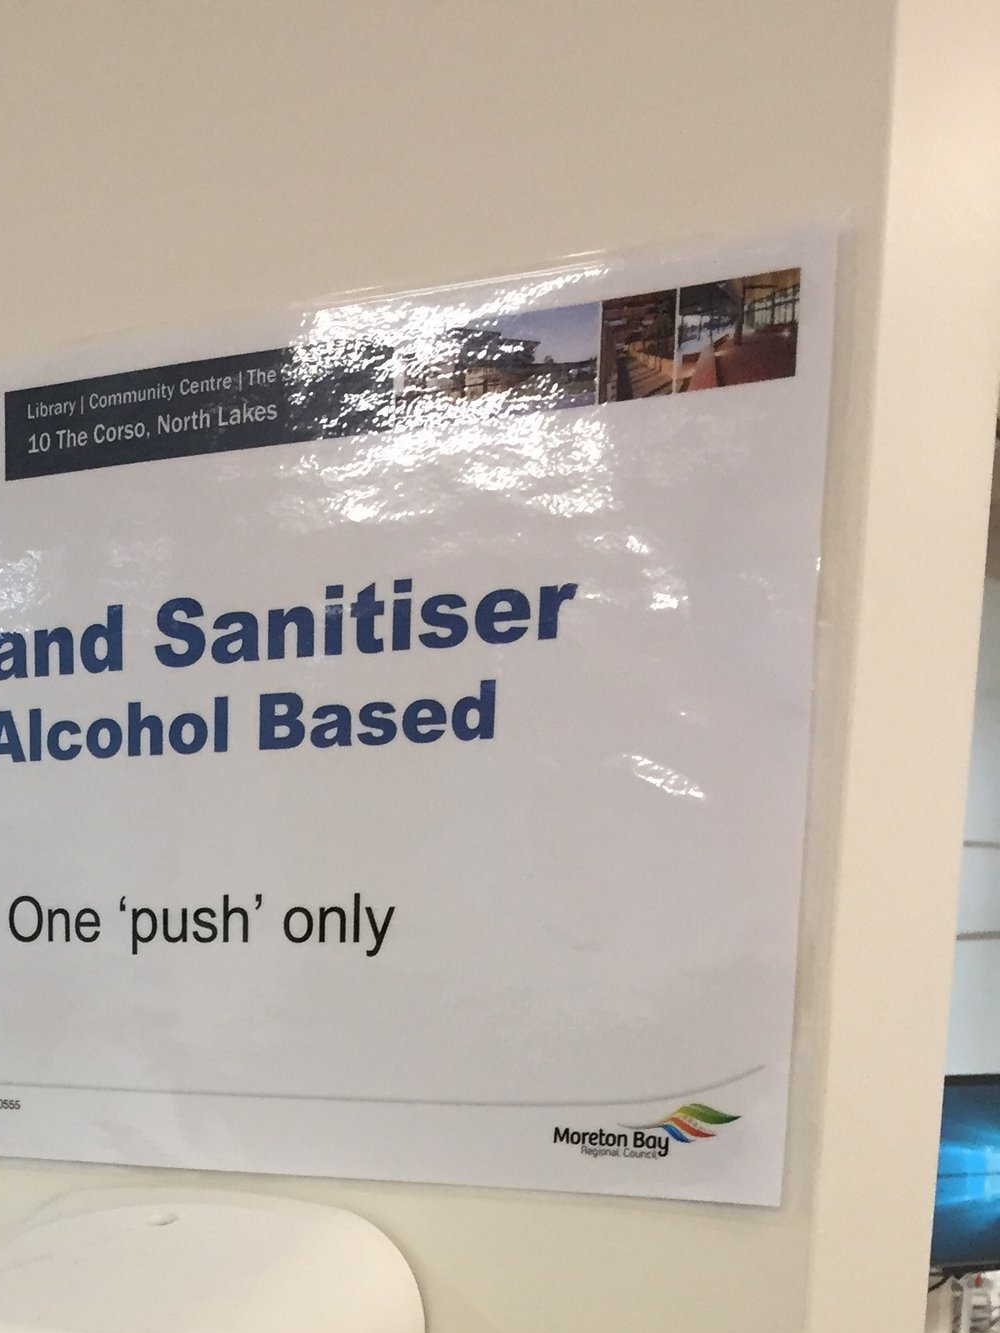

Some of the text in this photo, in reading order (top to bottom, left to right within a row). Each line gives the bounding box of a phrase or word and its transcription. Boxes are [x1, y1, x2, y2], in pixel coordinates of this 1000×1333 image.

[27, 400, 76, 419] Library
[89, 383, 175, 410] Community
[179, 373, 232, 397] Centre
[247, 368, 277, 386] The
[28, 402, 278, 453] 10 The Corso, North Lakes
[154, 578, 579, 668] Sanitiser
[258, 679, 496, 750] Based
[8, 895, 101, 944] One
[283, 893, 395, 957] only
[553, 1126, 669, 1157] Moreton Bay
[581, 1145, 658, 1160] Regional Council
